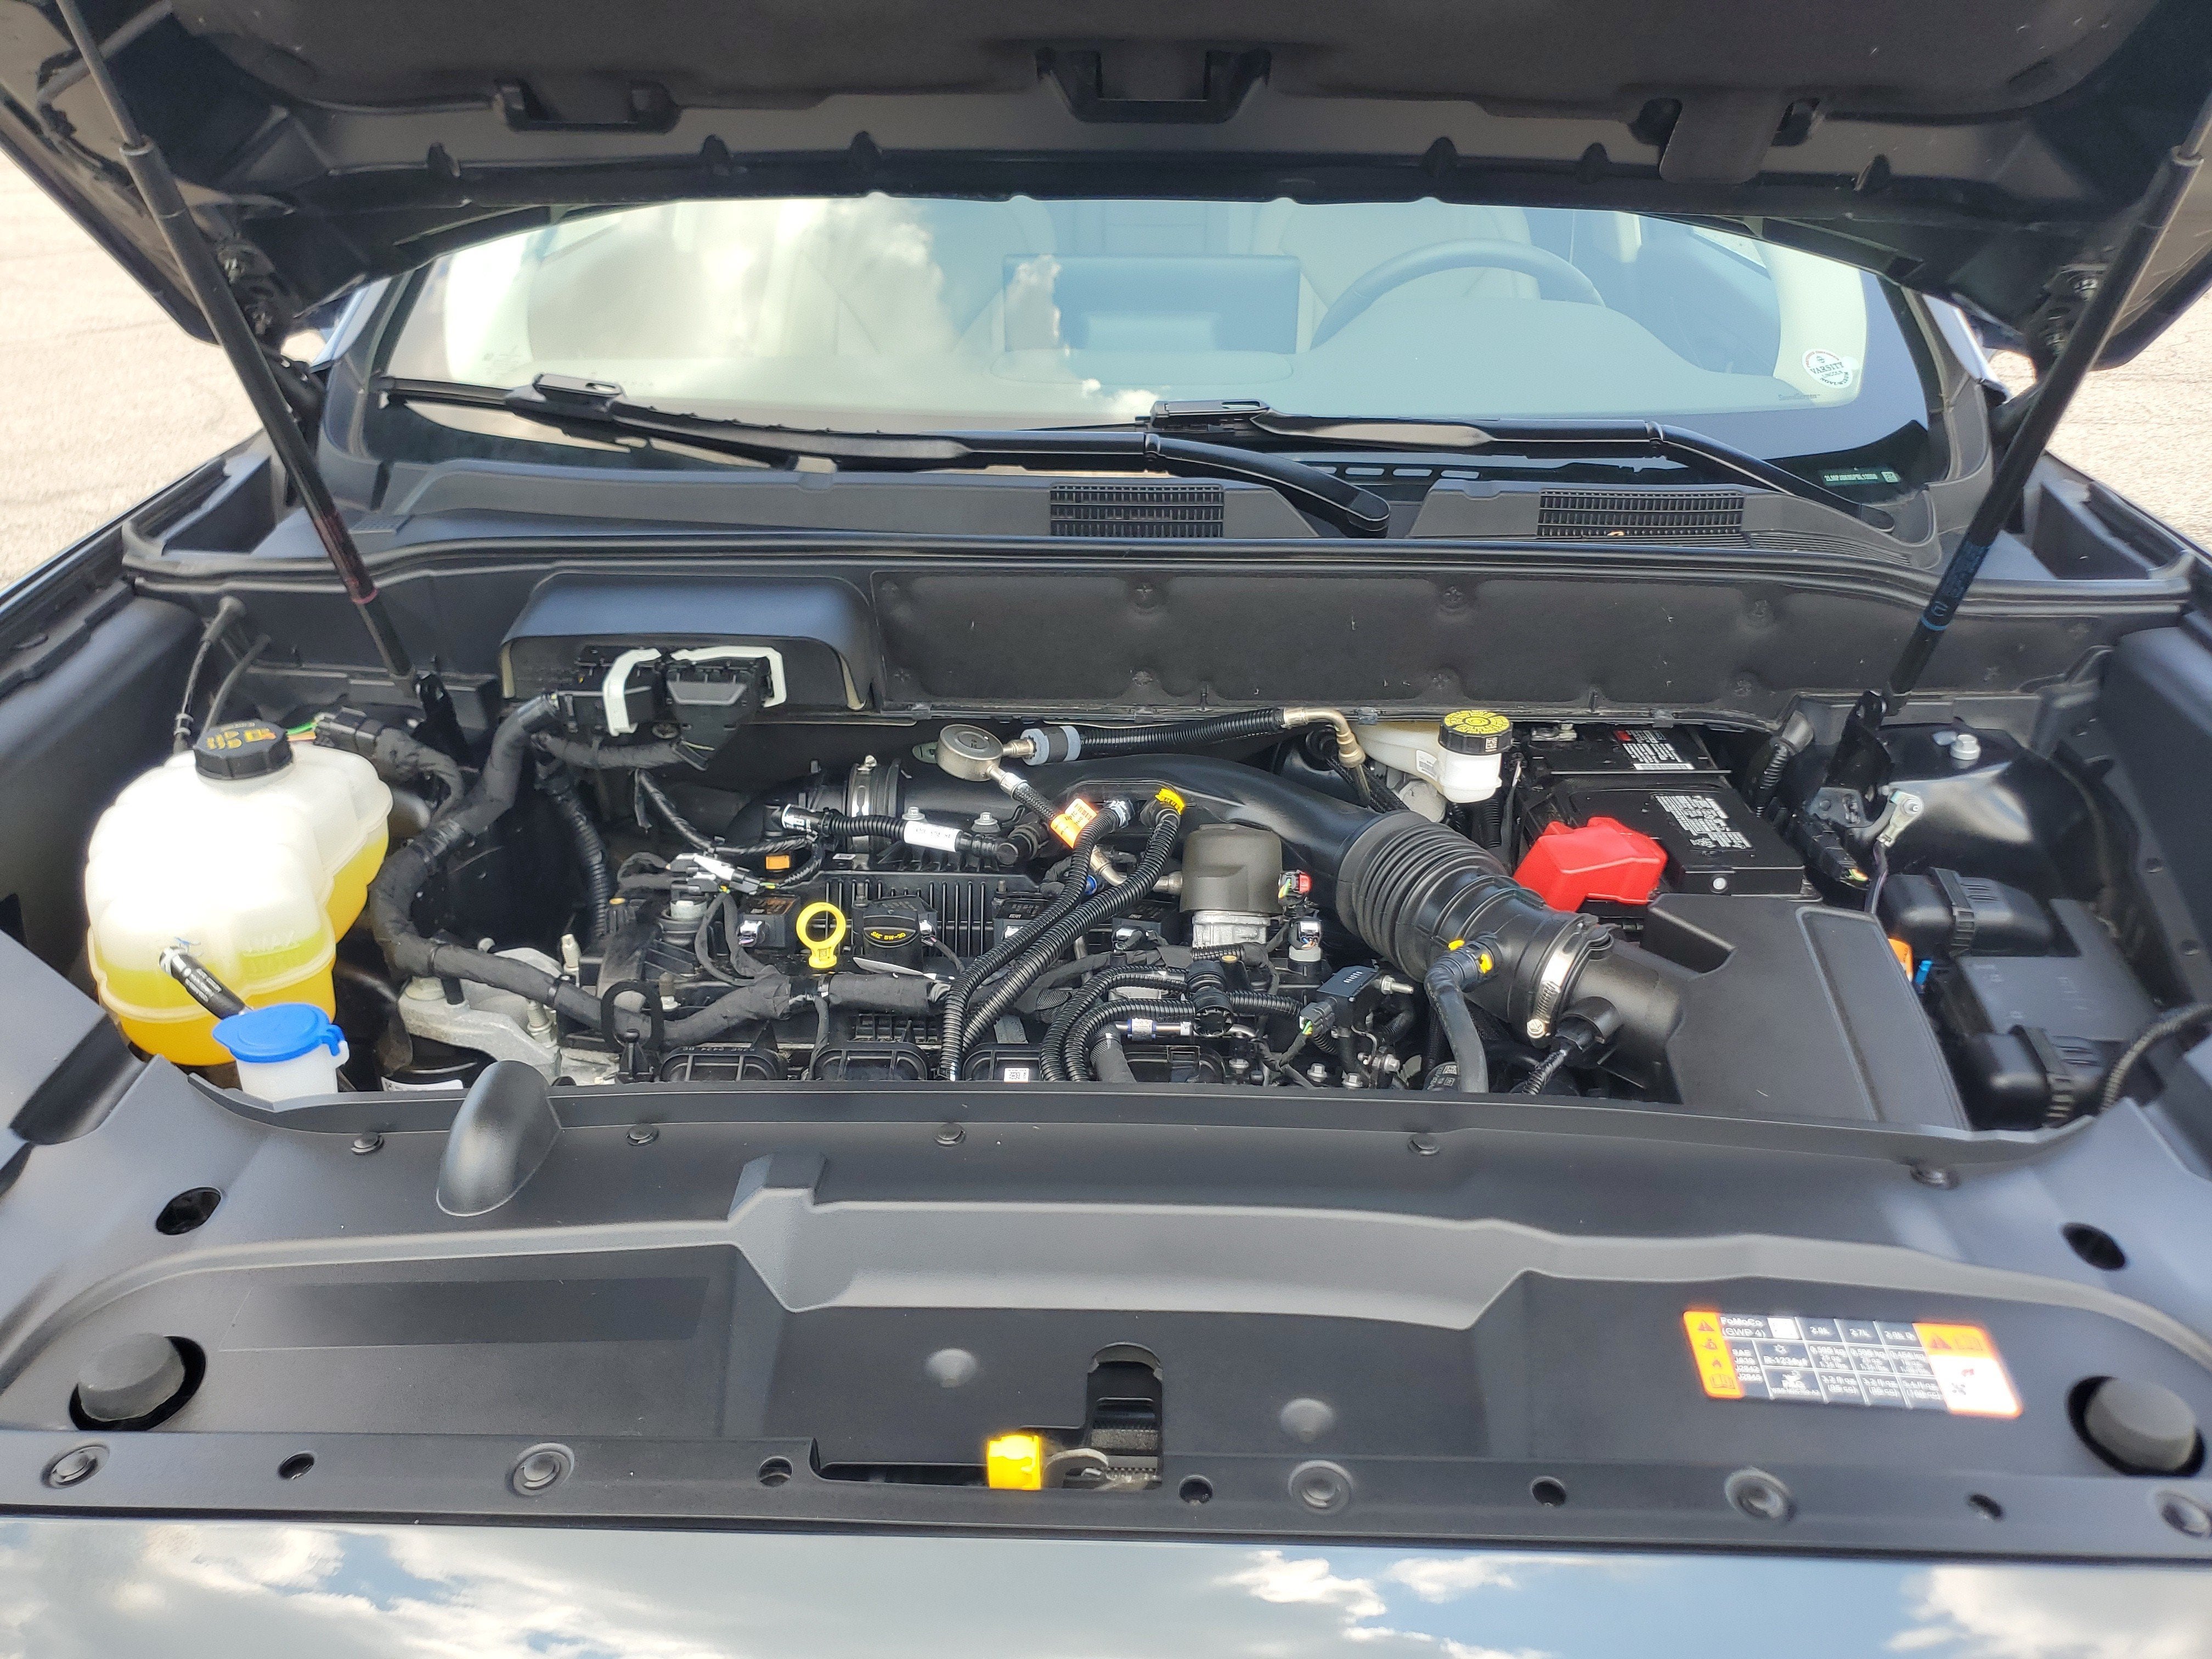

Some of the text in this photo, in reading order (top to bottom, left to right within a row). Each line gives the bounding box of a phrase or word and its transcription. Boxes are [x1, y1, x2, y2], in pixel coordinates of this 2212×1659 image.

[1810, 362, 1844, 374] VARSITY
[1720, 1317, 1763, 1327] FoMoCo
[1732, 1348, 1752, 1357] SAE
